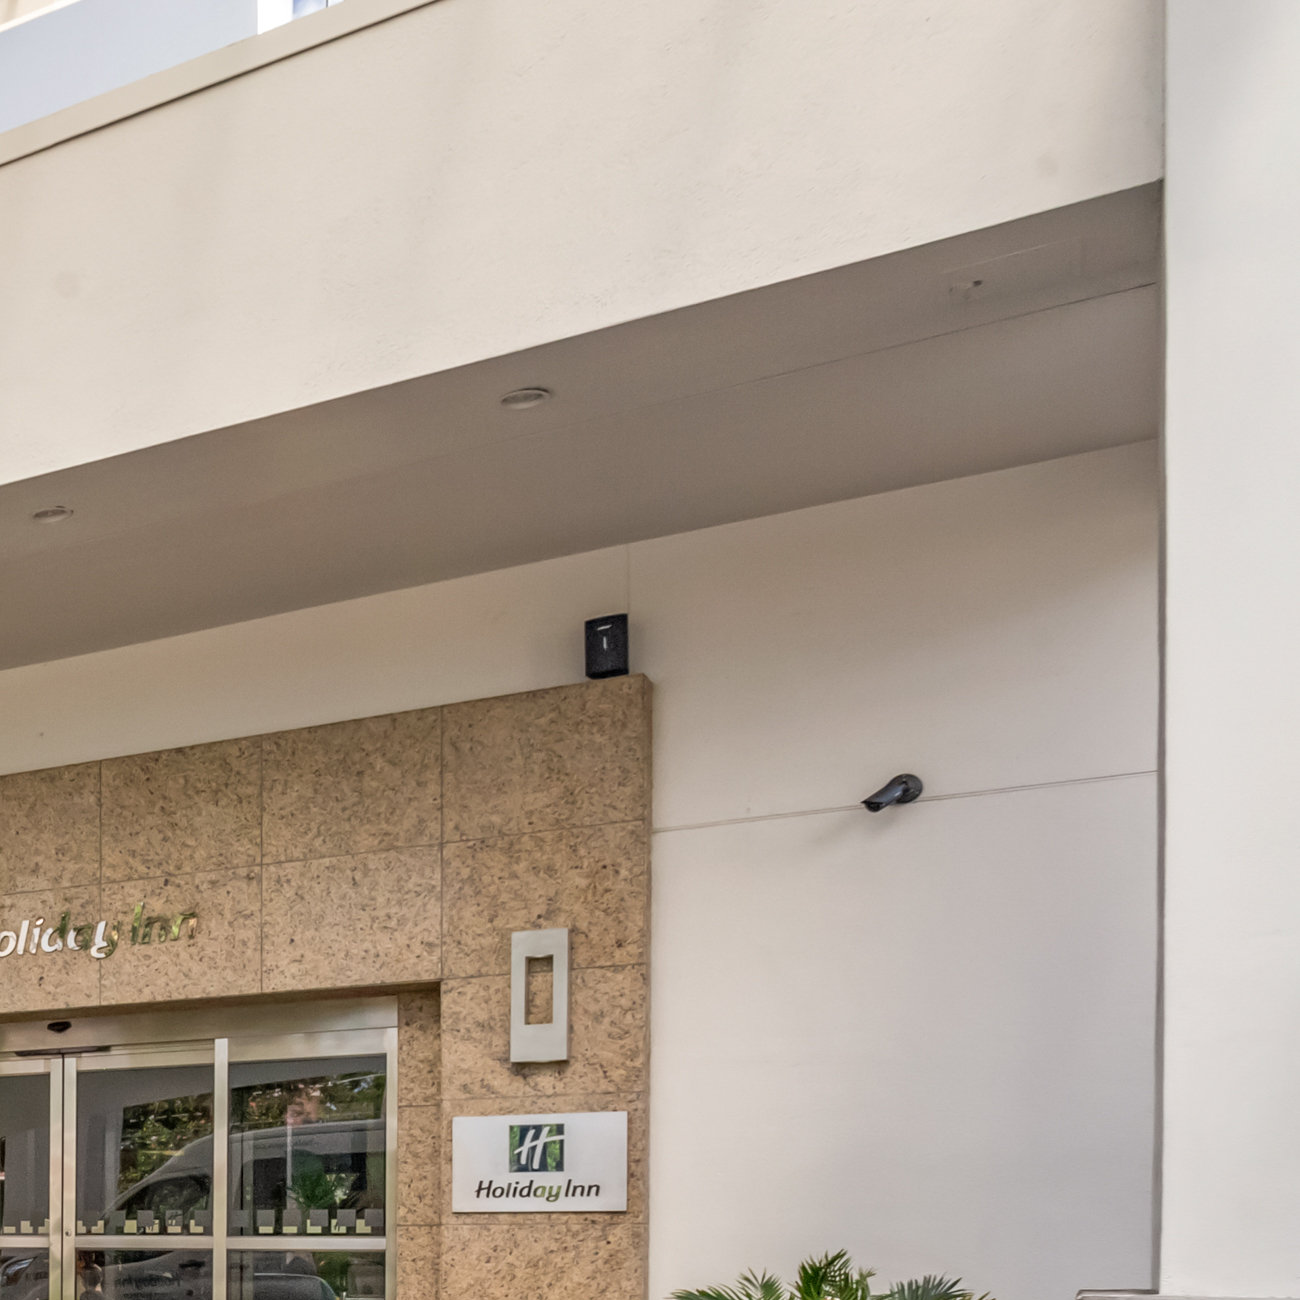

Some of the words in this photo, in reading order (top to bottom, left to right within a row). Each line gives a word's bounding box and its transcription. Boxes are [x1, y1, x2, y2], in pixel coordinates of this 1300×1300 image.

[130, 902, 198, 946] Inn
[475, 1180, 562, 1203] Holiday
[565, 1179, 601, 1198] Inn
